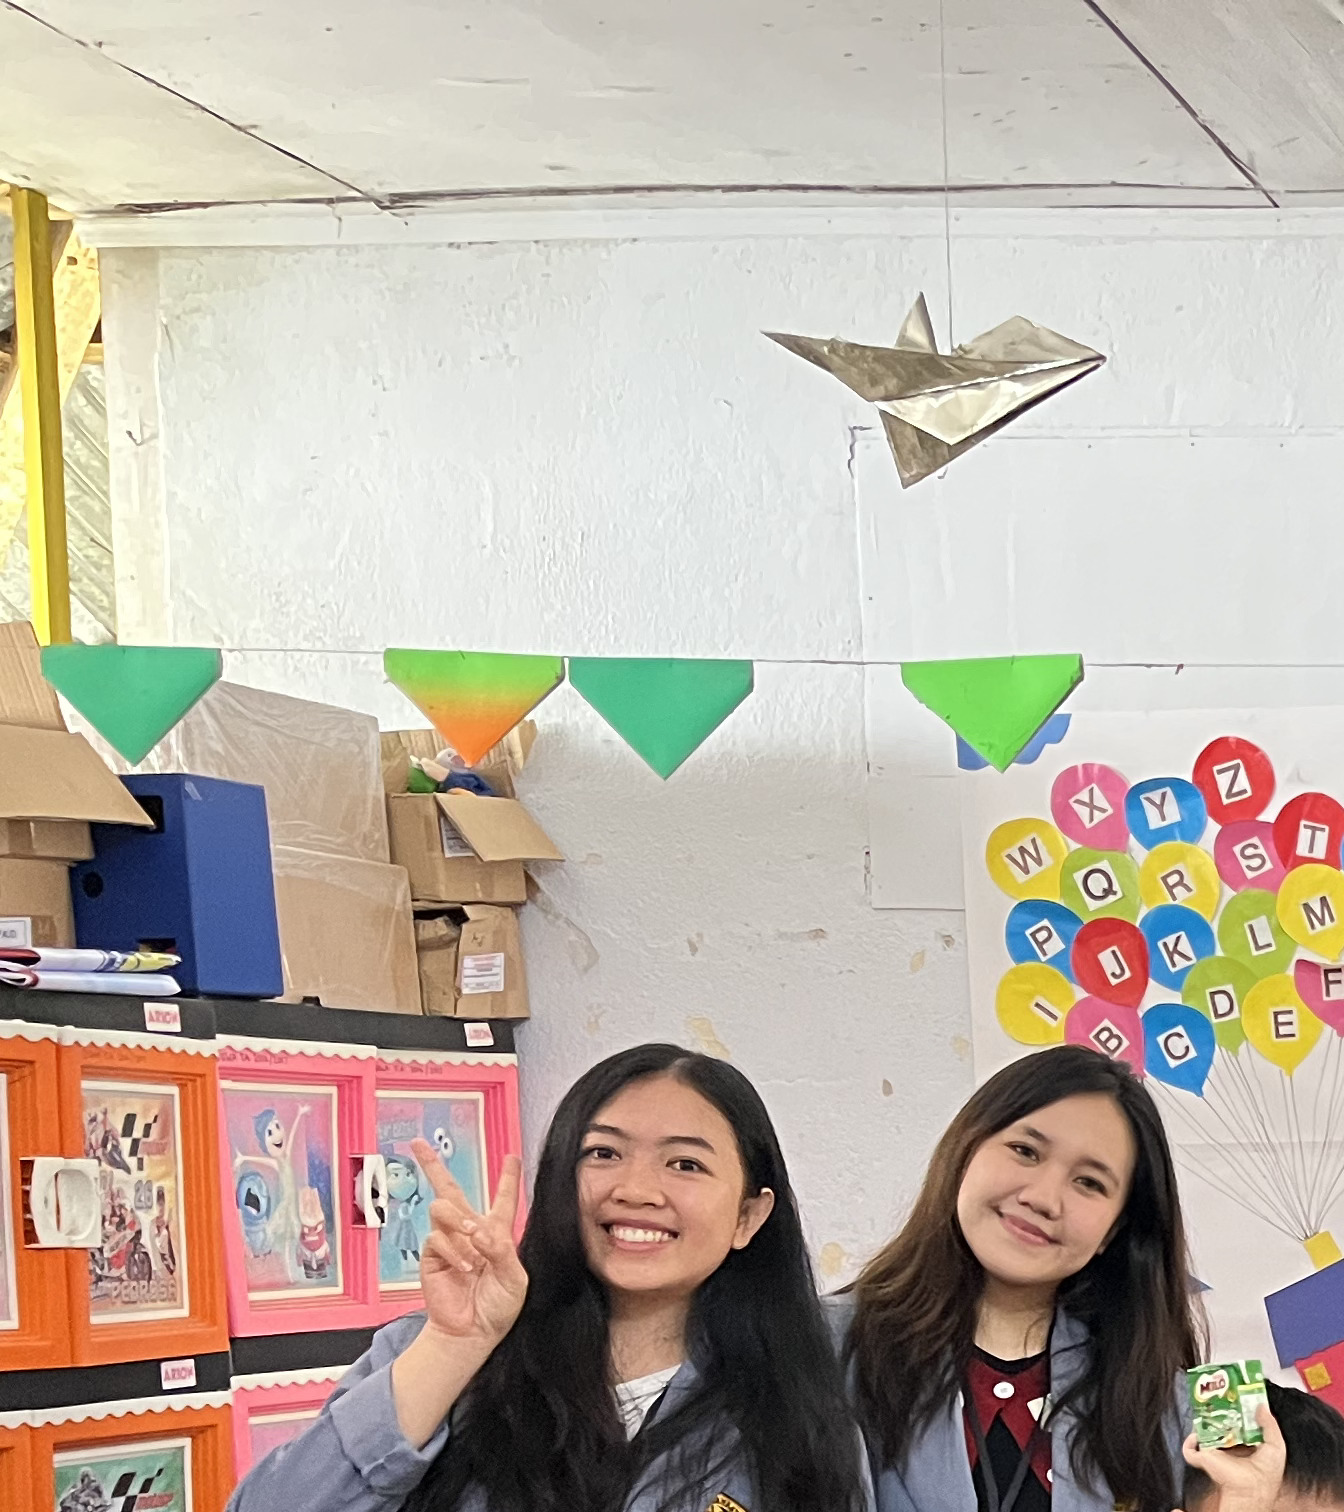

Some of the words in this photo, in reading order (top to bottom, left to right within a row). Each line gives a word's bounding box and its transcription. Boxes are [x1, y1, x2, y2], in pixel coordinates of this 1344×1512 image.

[1005, 837, 1042, 875] W
[1073, 787, 1108, 824] X
[1143, 791, 1167, 822] Y
[1216, 763, 1248, 799] Z
[1029, 926, 1053, 957] P
[1082, 868, 1117, 901] Q
[1161, 869, 1193, 901] R
[1240, 843, 1266, 872] S
[1303, 824, 1325, 853] T
[1034, 1002, 1058, 1021] I
[1108, 949, 1126, 980] J
[1163, 935, 1192, 968] K
[1248, 924, 1272, 951] L
[1302, 896, 1335, 930] M
[1096, 1025, 1124, 1055] B
[1164, 1032, 1189, 1060] C
[1209, 990, 1234, 1019] D
[1273, 1010, 1296, 1039] E
[1323, 968, 1342, 997] F
[1200, 1379, 1225, 1395] MILO
